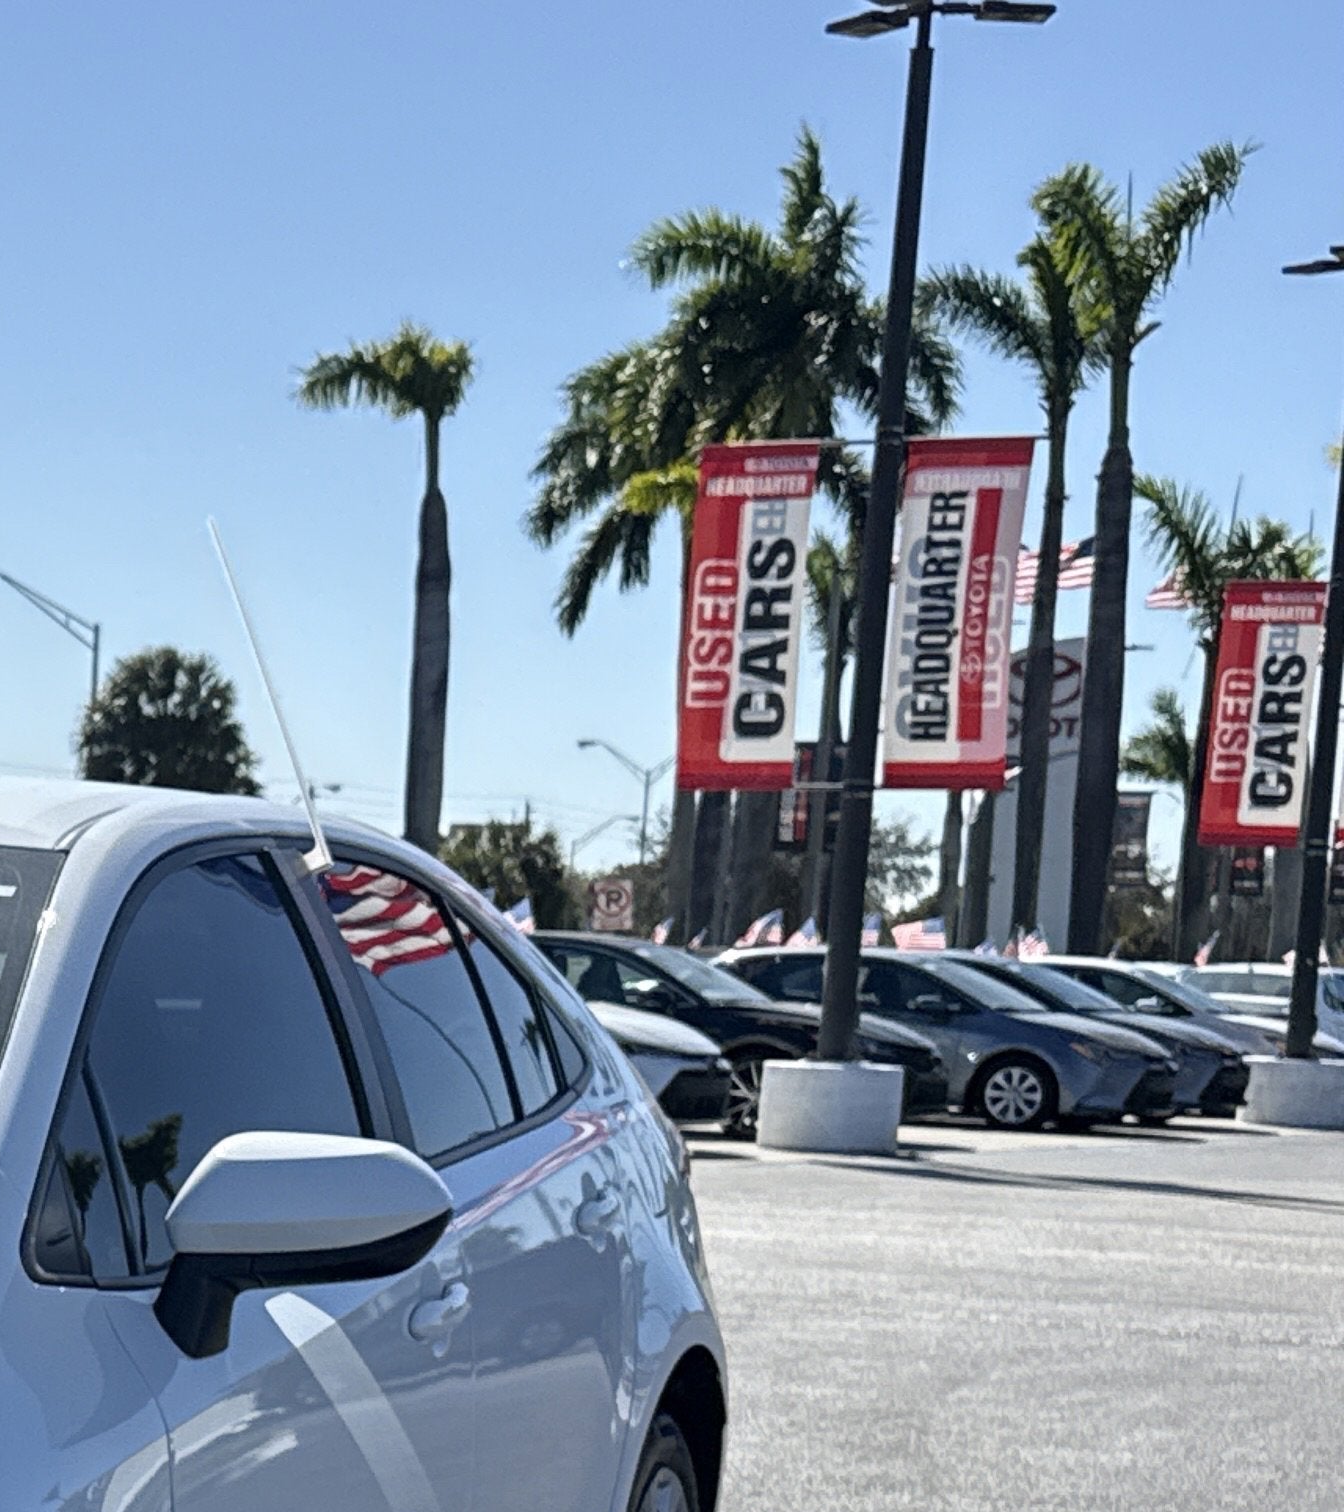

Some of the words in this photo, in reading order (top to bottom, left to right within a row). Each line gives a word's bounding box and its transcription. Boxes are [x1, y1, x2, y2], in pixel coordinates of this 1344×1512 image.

[706, 474, 808, 497] HEADQUARTER
[685, 558, 740, 708] USED
[733, 538, 796, 739] CARS
[909, 490, 969, 742] HEADQUARTER
[965, 553, 990, 650] TOYOTA
[1211, 668, 1256, 783] USED
[1249, 654, 1307, 808] CARS
